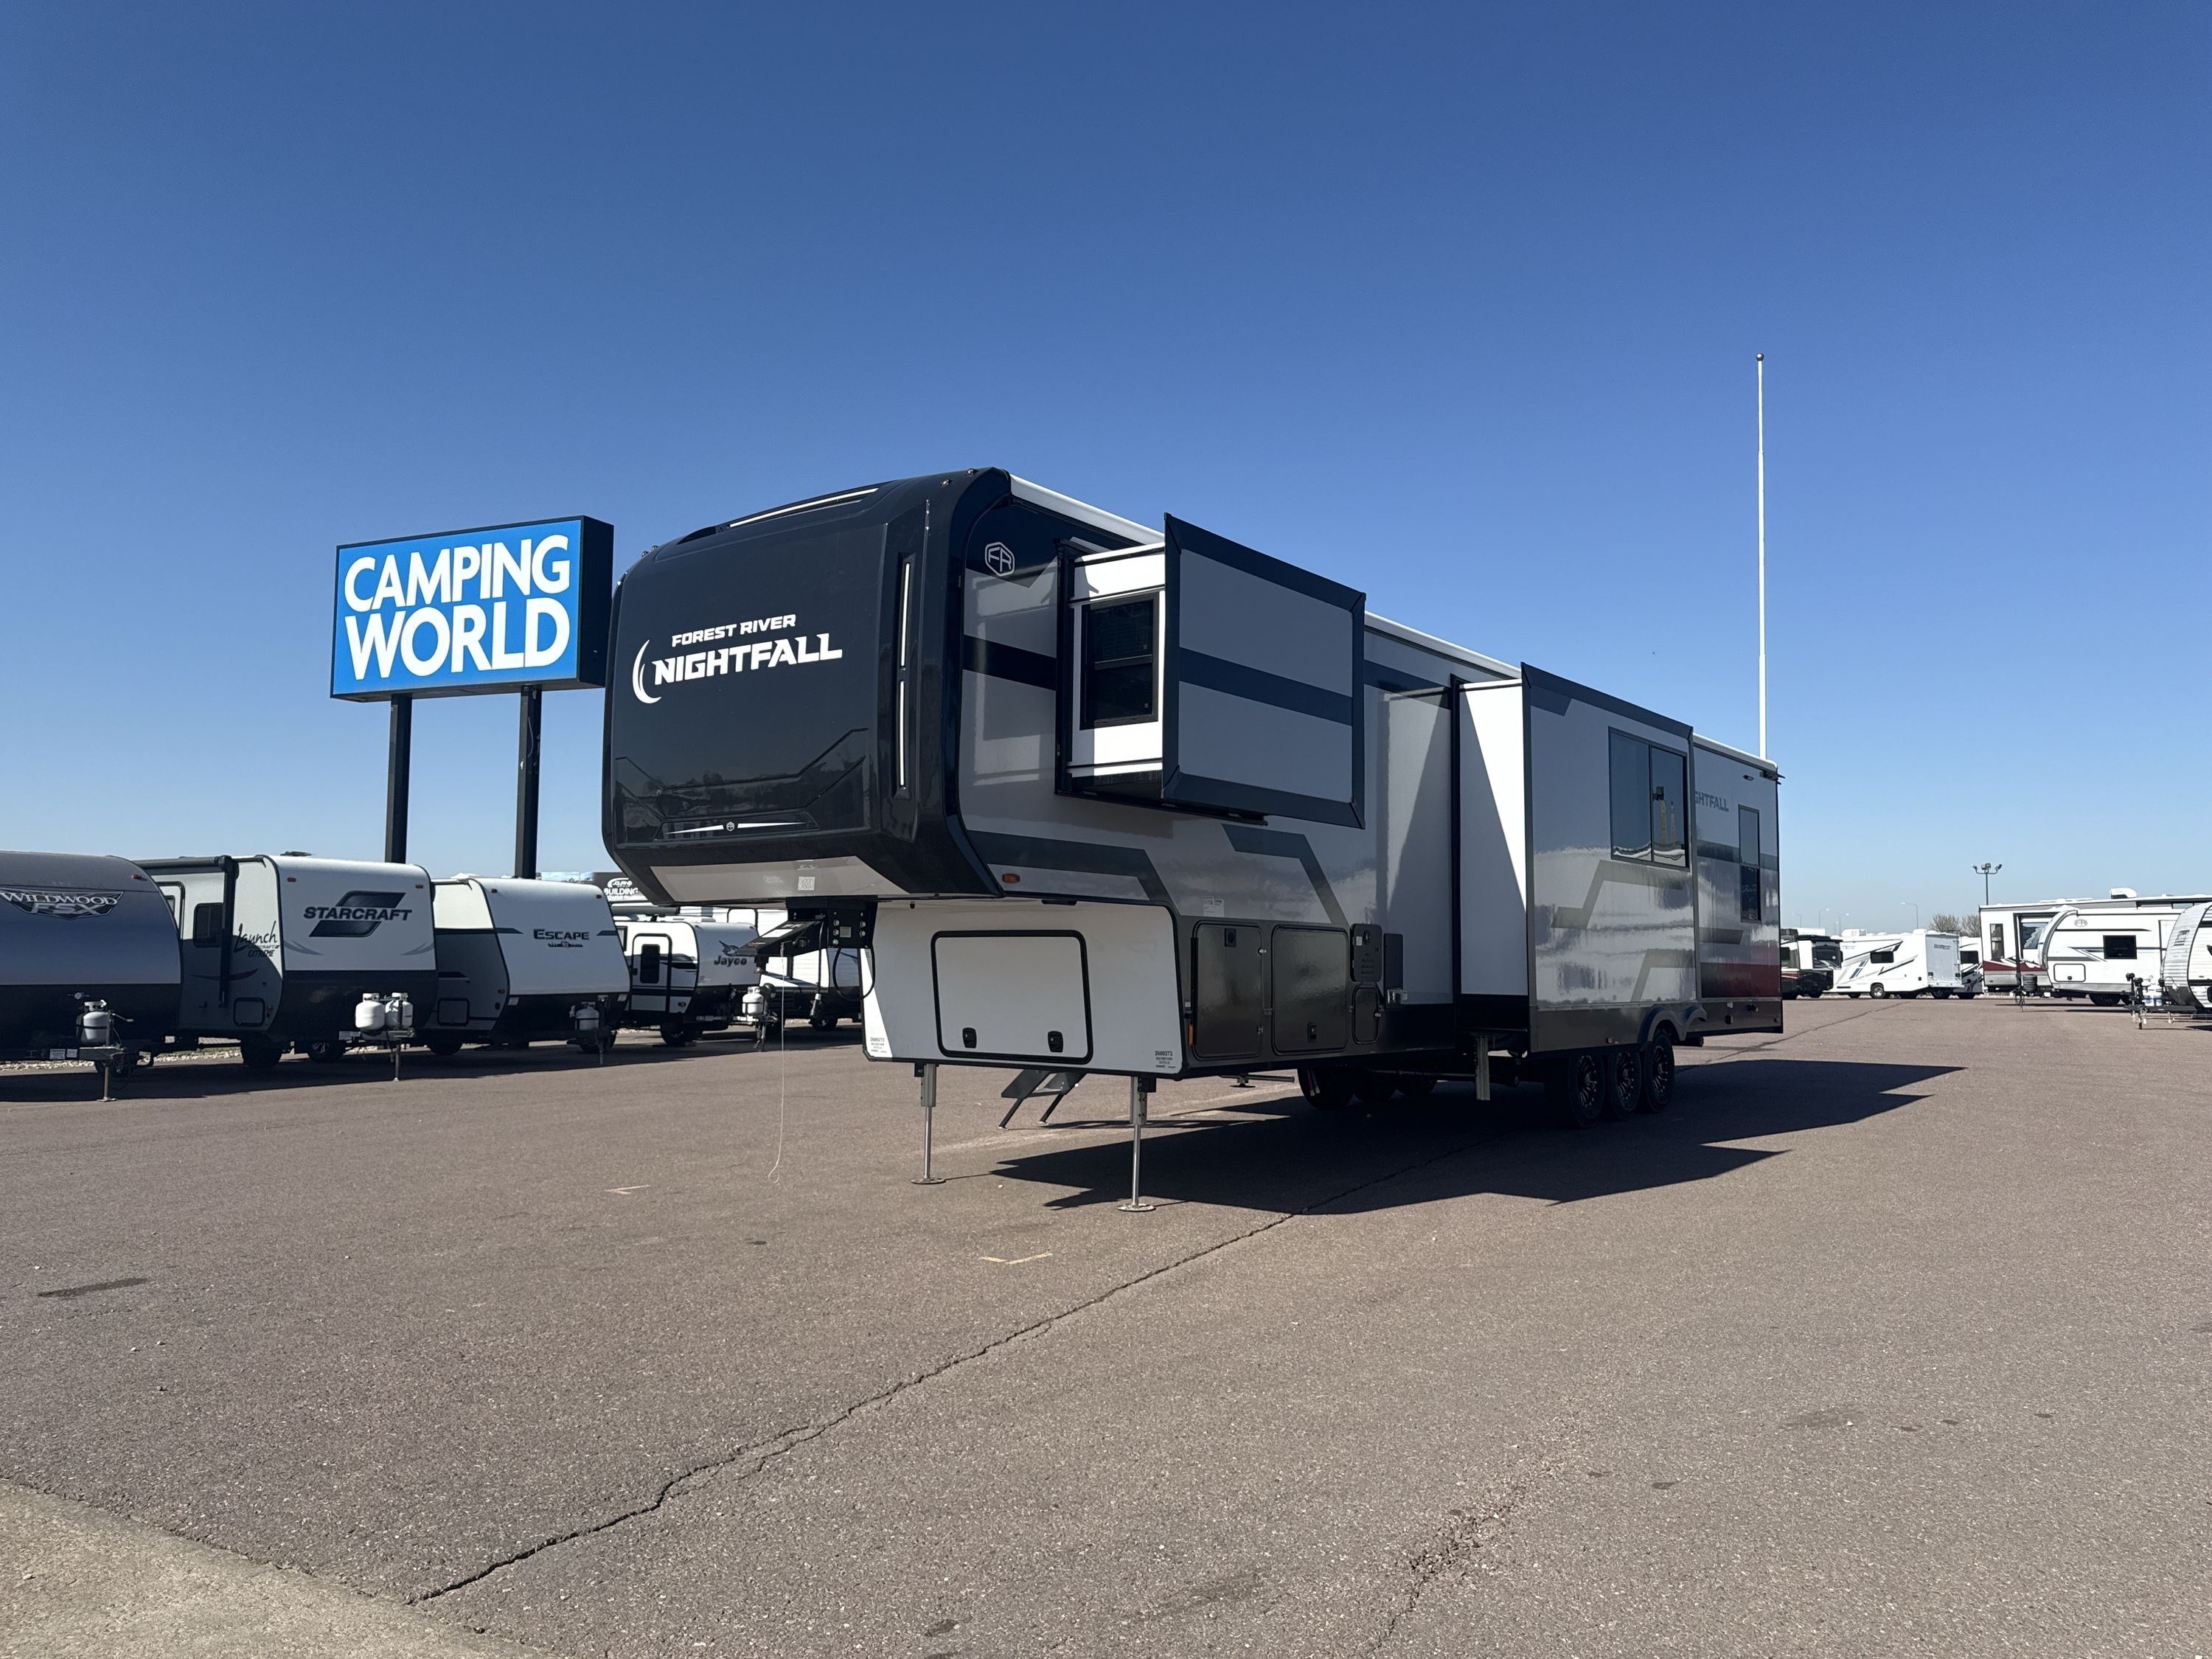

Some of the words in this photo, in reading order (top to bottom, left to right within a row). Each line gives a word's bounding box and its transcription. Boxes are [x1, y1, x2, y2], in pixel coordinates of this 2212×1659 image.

[344, 534, 571, 613] CAMPING
[344, 597, 571, 681] WORLD
[672, 623, 737, 647] FOREST
[740, 613, 796, 635] RIVER
[651, 633, 843, 685] NIGHTFALL
[1695, 790, 1729, 812] GHTFALL
[0, 892, 118, 905] WILDWOOD
[31, 902, 104, 915] FSX
[303, 906, 413, 921] STARCRAFT
[234, 920, 278, 953] Launch
[533, 929, 590, 940] ESCAPE
[714, 956, 747, 967] Jayco
